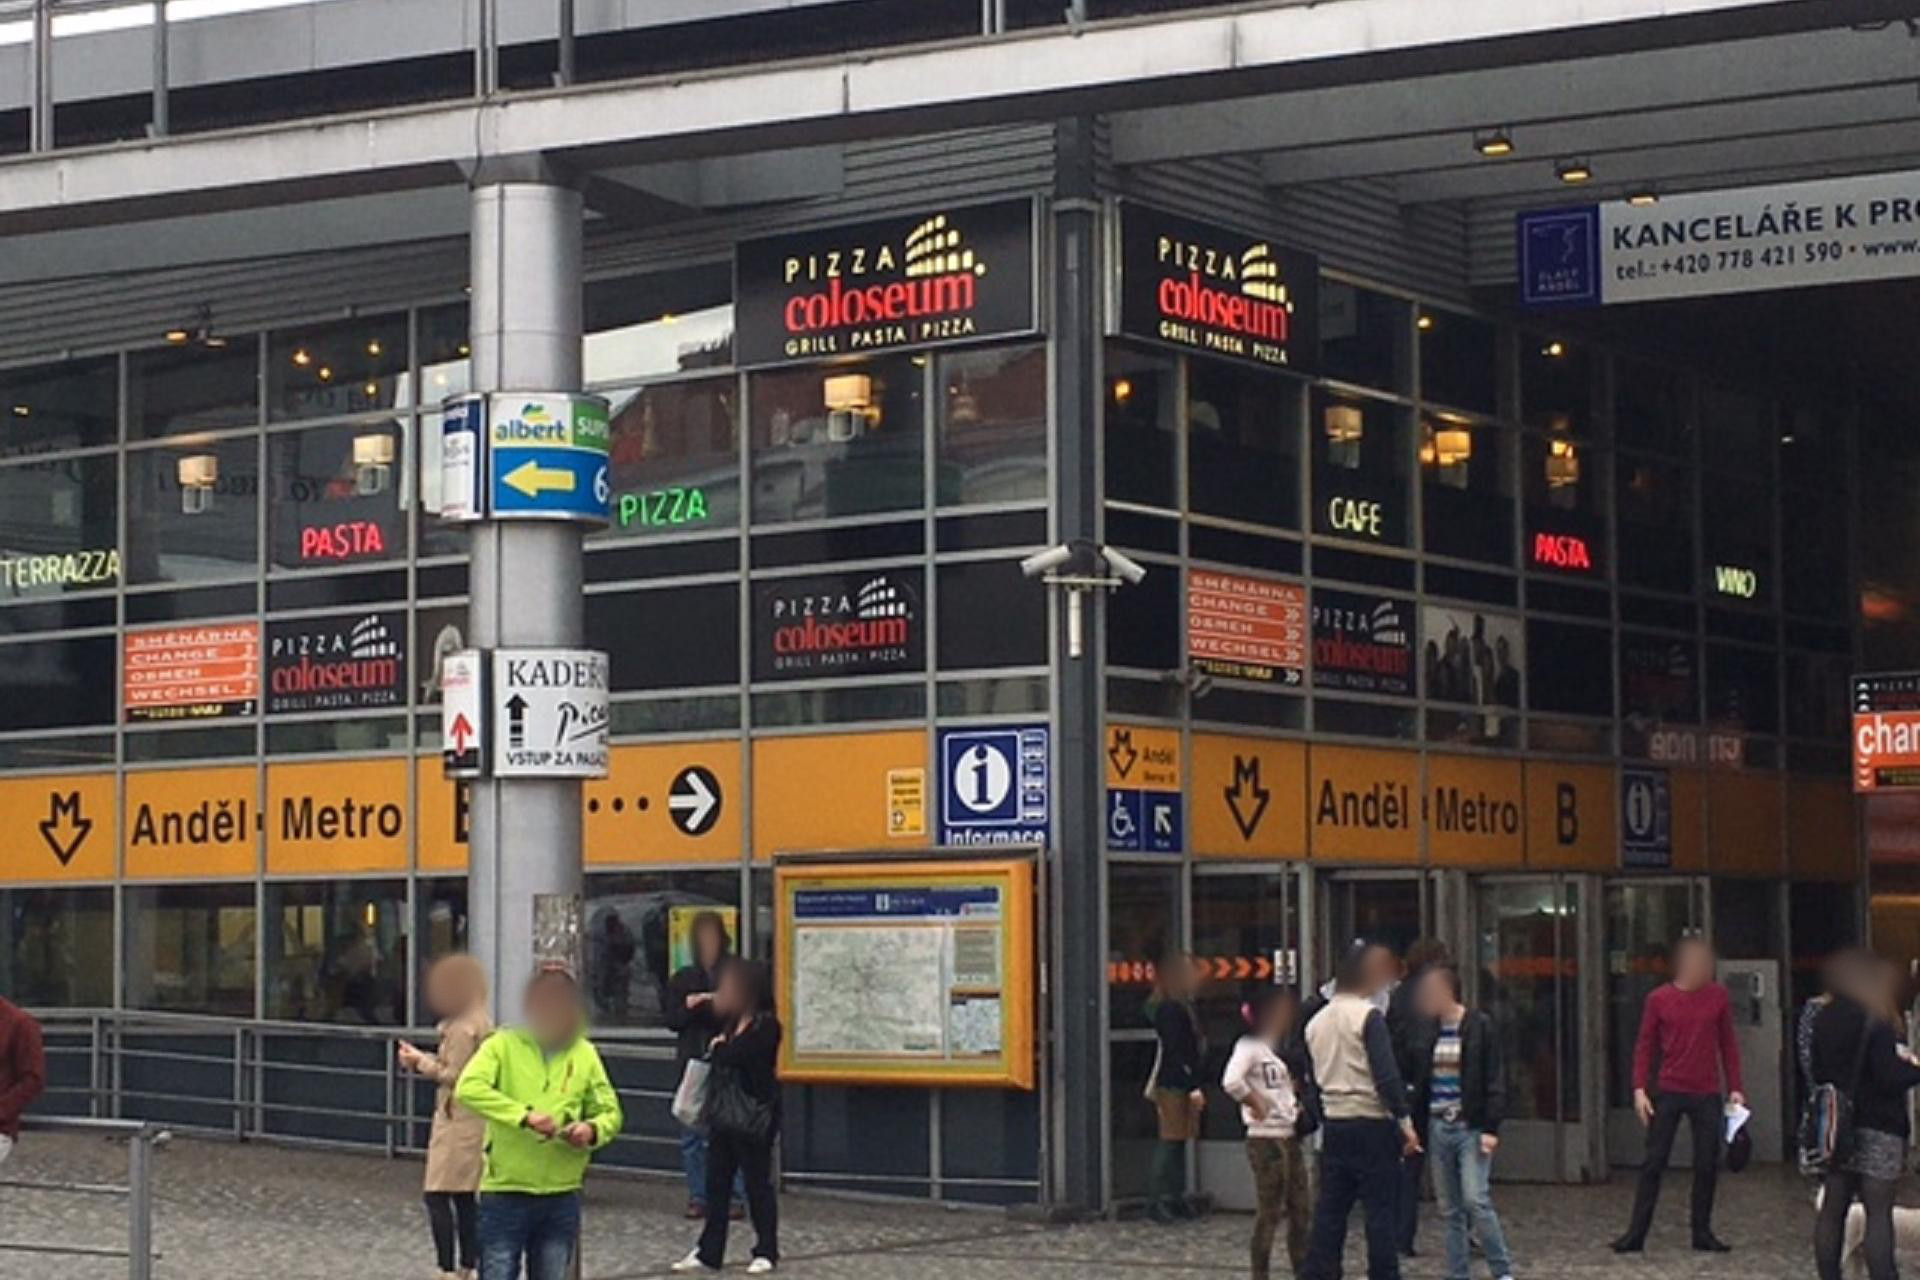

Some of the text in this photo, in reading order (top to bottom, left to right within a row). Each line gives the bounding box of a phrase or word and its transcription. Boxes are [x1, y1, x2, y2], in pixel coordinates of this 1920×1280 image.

[1613, 198, 1920, 249] KANCELÁŘE K PR
[784, 245, 894, 283] PIZZA
[1158, 236, 1236, 280] PIZZA
[1616, 260, 1657, 280] tel.:
[1661, 253, 1710, 275] +420
[1718, 249, 1753, 270] 778
[1761, 245, 1795, 266] 421
[1805, 241, 1843, 262] 590
[784, 272, 976, 333] coloseum
[1158, 271, 1289, 341] coloseum
[784, 317, 976, 356] GRILL PASTA PIZZA
[1159, 320, 1288, 364] GRILL PASTA PIZZA
[495, 419, 565, 441] albert
[592, 465, 609, 504] 6
[620, 488, 707, 528] PIZZA
[301, 522, 384, 559] PASTA
[1534, 533, 1591, 569] PASTA
[1, 549, 120, 588] TERRAZZA
[774, 595, 851, 619] PIZZA
[1190, 592, 1268, 616] CHANGE
[272, 634, 346, 656] PIZZA
[774, 615, 908, 655] coloseum
[1190, 637, 1283, 659] WECHSEL
[131, 647, 218, 664] CHANGE
[869, 648, 907, 661] PIZZA
[131, 684, 237, 700] WECHSEL
[272, 656, 396, 694] coloseum
[506, 752, 552, 766] VSTUP
[555, 752, 574, 766] ZA
[131, 800, 247, 846] Anděl
[282, 797, 402, 842] Metro
[1317, 779, 1409, 831] Anděl
[1436, 787, 1520, 835] Metro
[1556, 783, 1578, 845] B
